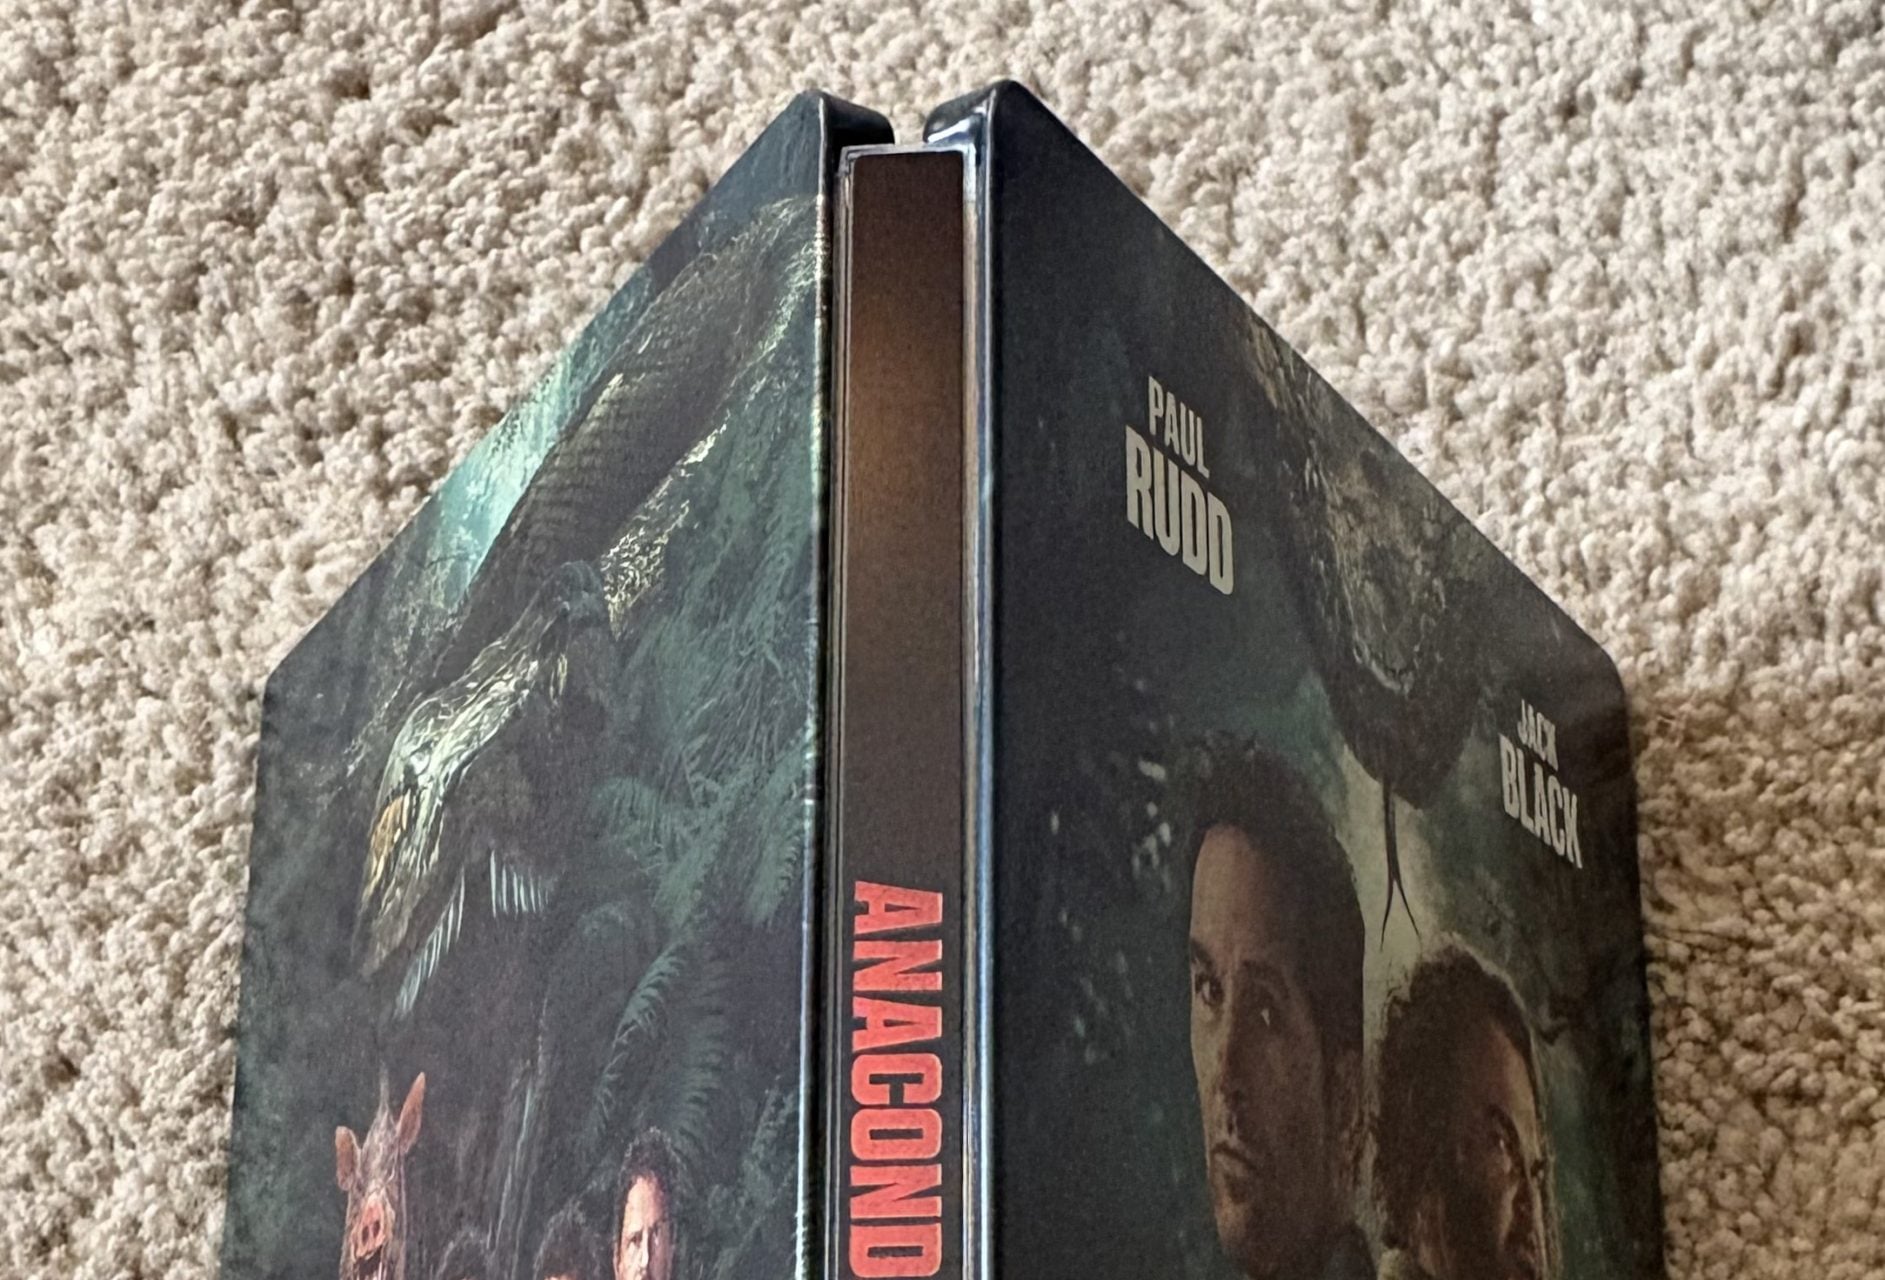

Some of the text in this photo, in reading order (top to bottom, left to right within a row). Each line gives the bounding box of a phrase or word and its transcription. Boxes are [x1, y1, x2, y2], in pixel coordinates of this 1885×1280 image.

[1148, 375, 1210, 478] PAUL
[1125, 425, 1234, 595] RUDD
[1517, 699, 1559, 771] JACK
[1500, 734, 1583, 870] BLACK
